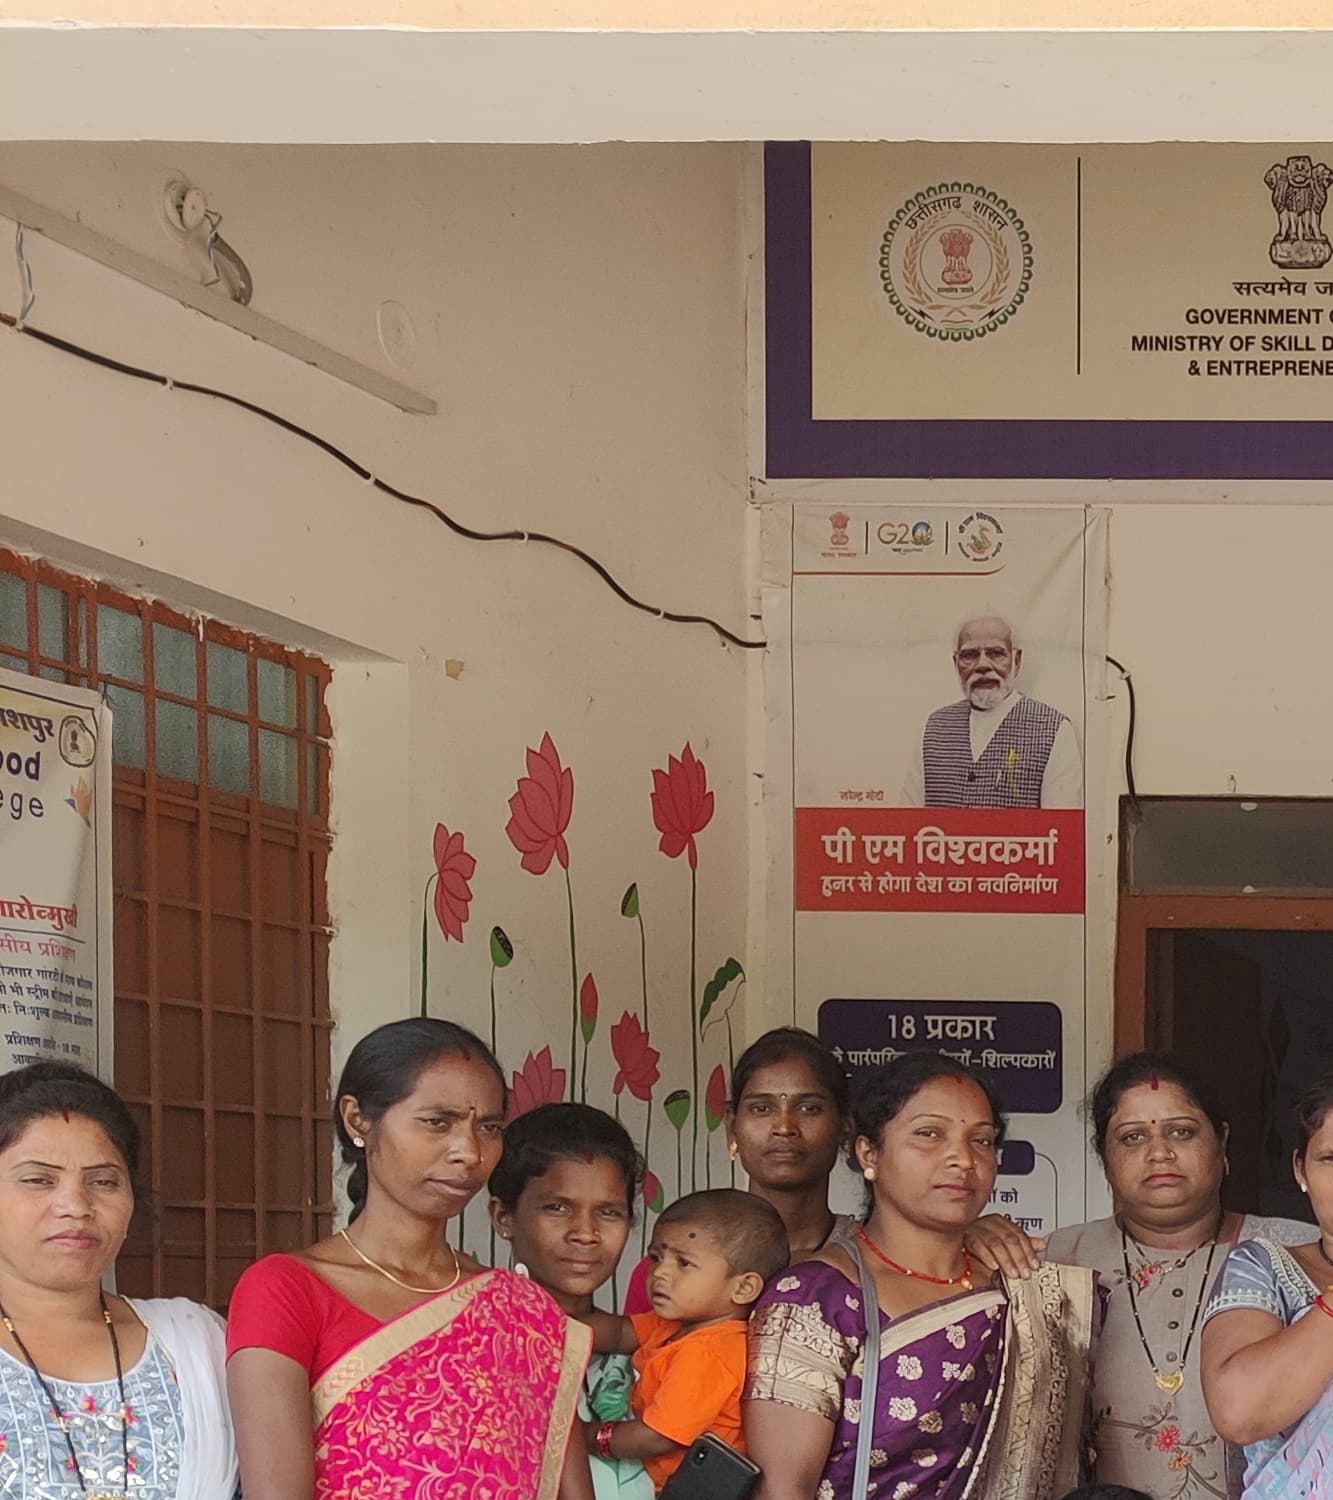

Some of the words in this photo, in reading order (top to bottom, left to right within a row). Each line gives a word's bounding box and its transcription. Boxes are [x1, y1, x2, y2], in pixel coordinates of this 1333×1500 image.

[973, 200, 1008, 231] शासन
[1233, 276, 1307, 297] सत्यमेव
[1185, 308, 1323, 326] GOVERNMENT
[1131, 335, 1225, 353] MINISTRY
[1230, 335, 1257, 353] OF
[1262, 335, 1316, 353] SKILL
[1187, 360, 1201, 377] &
[821, 826, 855, 864] पी
[862, 834, 906, 864] एम
[914, 826, 1060, 866] विश्वकर्मा
[820, 876, 854, 897] हुनर
[857, 872, 874, 893] से
[878, 875, 911, 894] होगा
[916, 874, 943, 894] देश
[948, 877, 972, 894] का
[977, 873, 1059, 896] नवनिर्माण
[888, 1014, 917, 1040] 18
[924, 1015, 997, 1041] प्रकार
[1001, 1188, 1018, 1203] को
